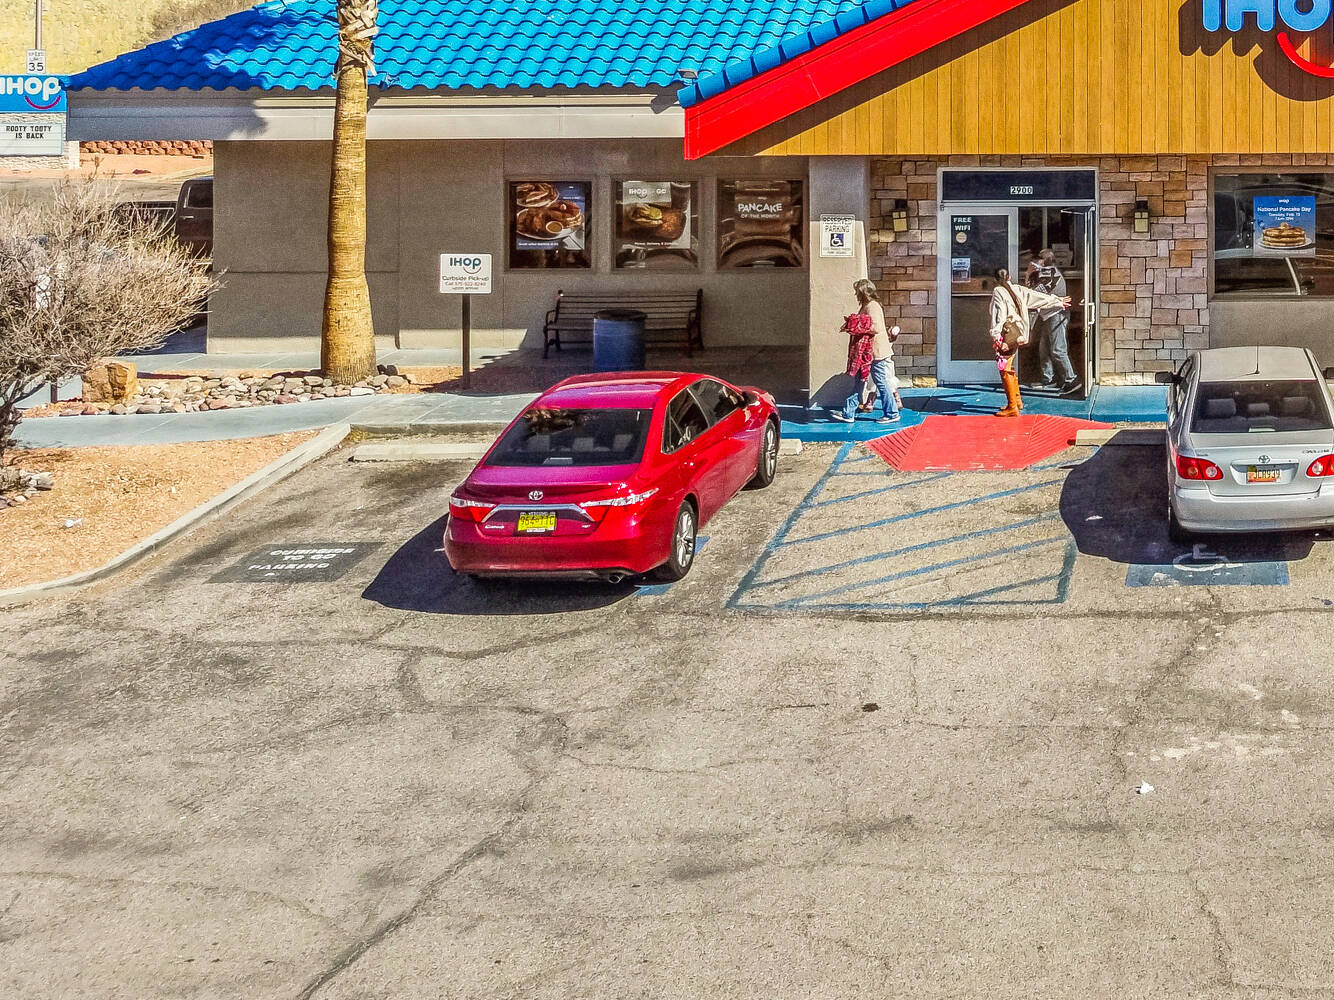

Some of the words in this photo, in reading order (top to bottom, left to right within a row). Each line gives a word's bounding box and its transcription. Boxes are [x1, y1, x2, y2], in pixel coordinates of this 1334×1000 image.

[28, 62, 44, 72] 35
[0, 77, 61, 101] IHOP
[1010, 186, 1033, 195] 2900
[738, 203, 783, 213] PANCAKE
[824, 225, 850, 233] PARKING
[450, 257, 482, 270] IHOP
[248, 562, 330, 571] PARKING
